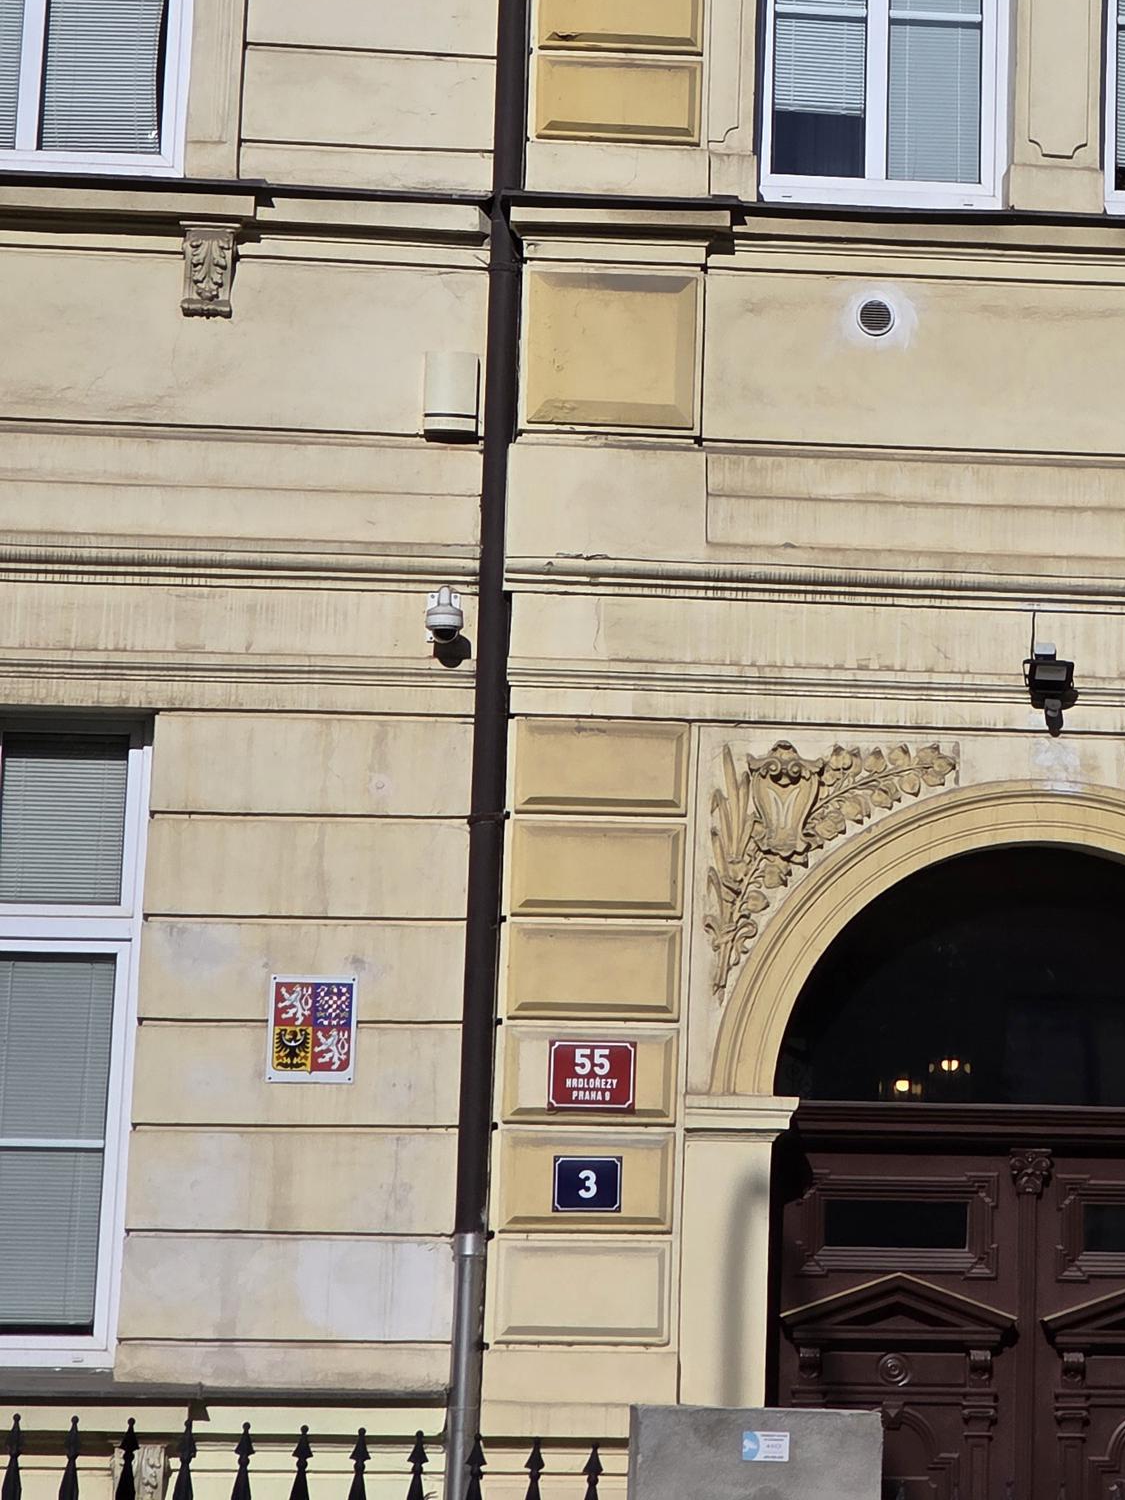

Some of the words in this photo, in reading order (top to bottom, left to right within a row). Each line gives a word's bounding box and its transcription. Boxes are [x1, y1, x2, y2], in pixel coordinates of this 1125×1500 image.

[574, 1049, 610, 1075] 55
[565, 1077, 617, 1089] HRDLOŘEZY
[572, 1090, 602, 1100] PRAHA
[604, 1090, 611, 1101] 9
[578, 1169, 597, 1199] 3
